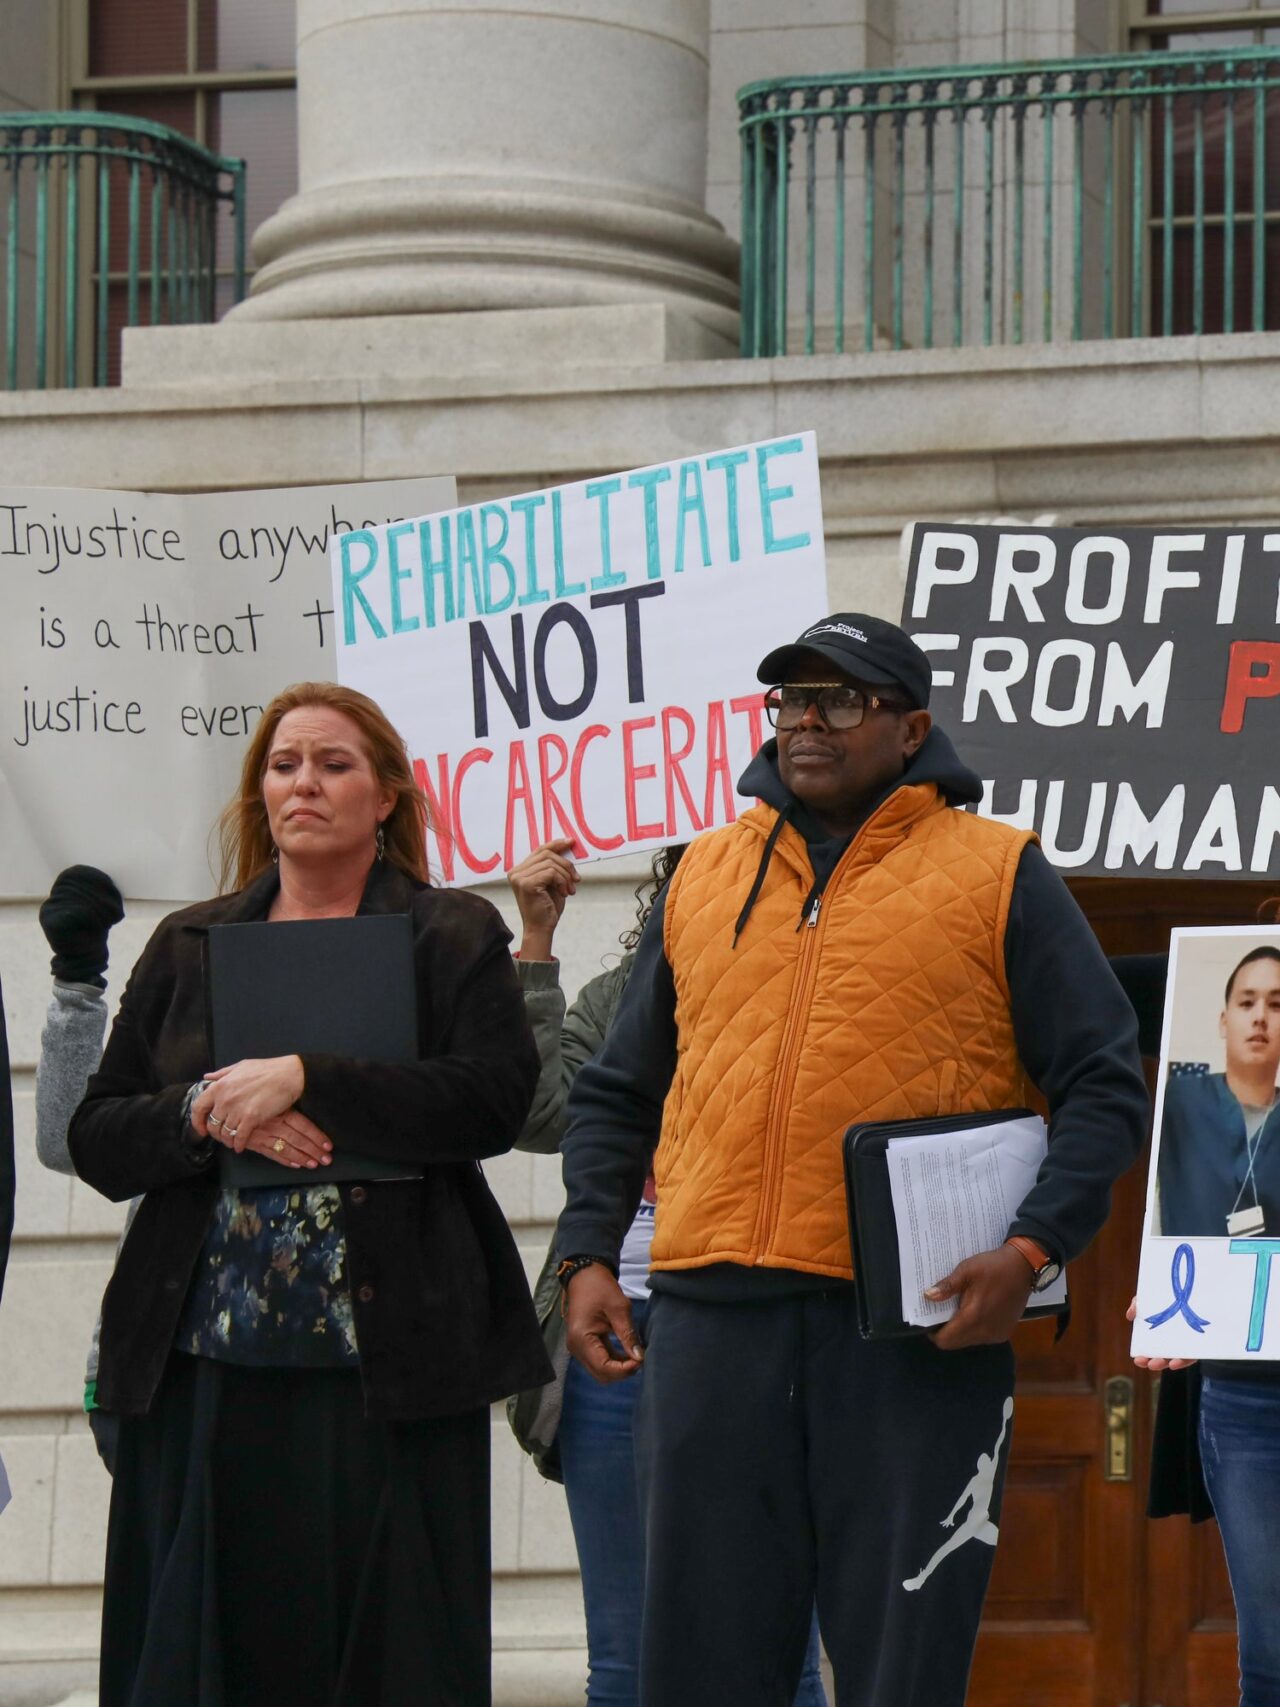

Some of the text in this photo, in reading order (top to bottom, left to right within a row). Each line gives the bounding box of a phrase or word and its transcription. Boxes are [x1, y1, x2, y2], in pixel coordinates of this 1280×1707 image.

[1, 505, 185, 574] Injustice
[340, 438, 811, 646] REHABILITATE
[39, 599, 334, 655] is a threat t
[468, 581, 666, 738] NOT
[13, 685, 264, 746] justice ever
[412, 692, 779, 882] NCARCERAT
